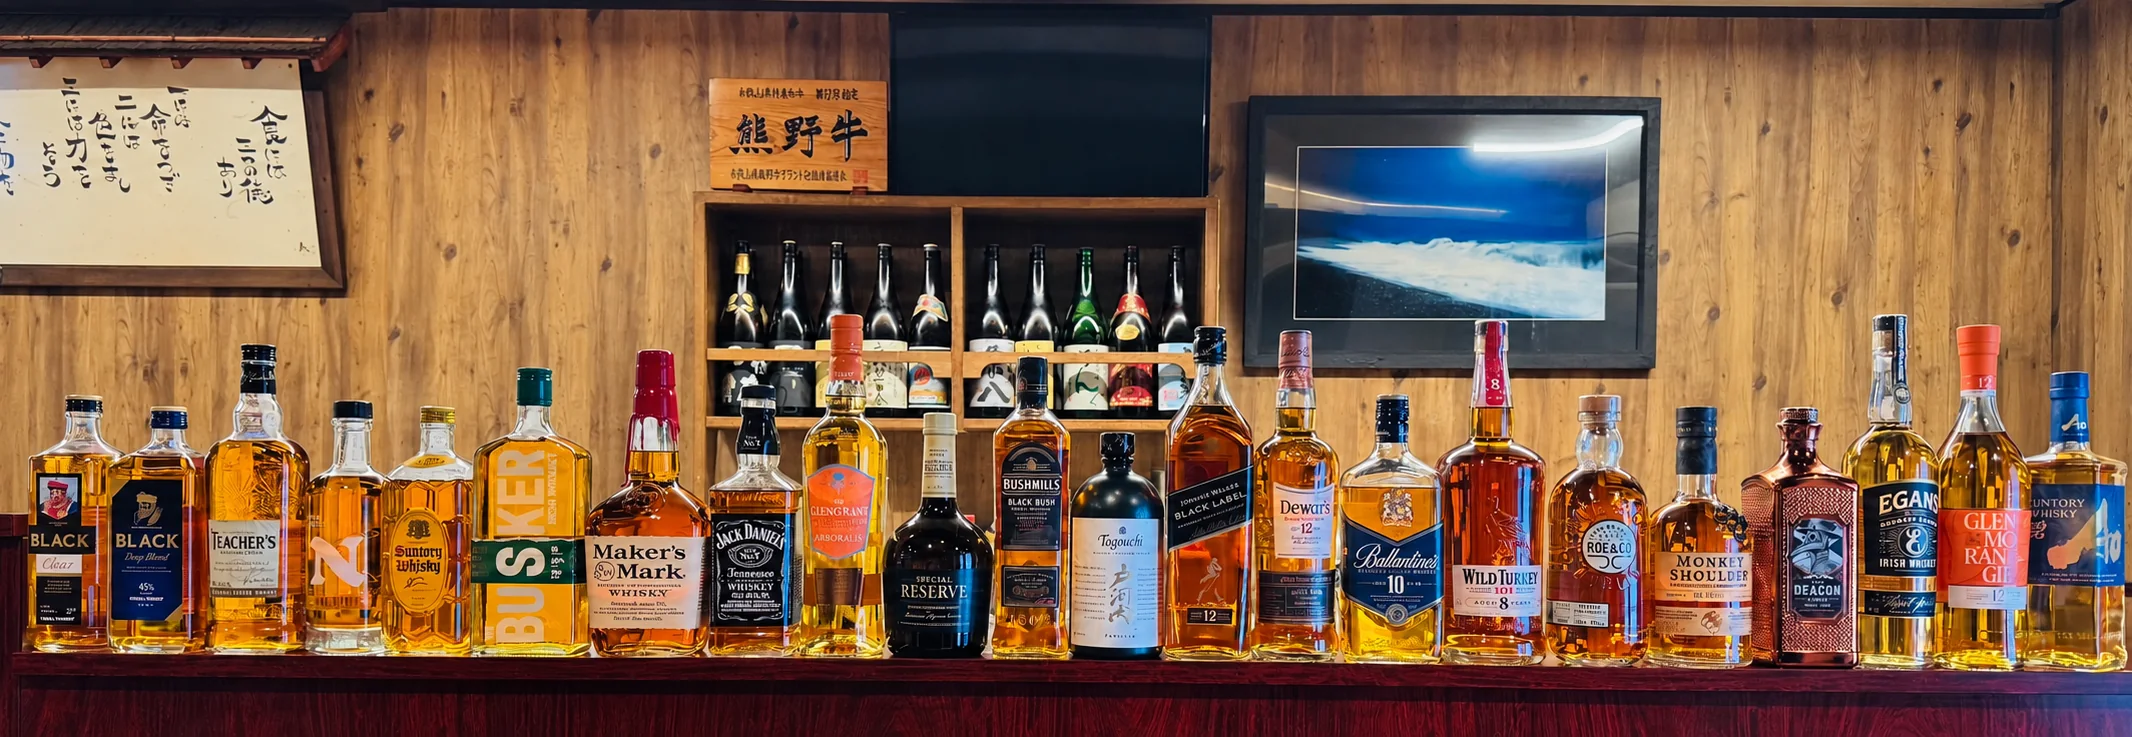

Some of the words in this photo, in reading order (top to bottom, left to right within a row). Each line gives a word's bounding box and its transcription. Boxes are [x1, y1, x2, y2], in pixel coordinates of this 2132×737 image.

[728, 109, 868, 163] 熊野牛
[1491, 378, 1500, 390] 8
[1003, 478, 1060, 490] BUSHMILLS
[1008, 498, 1033, 506] BLACK
[1035, 498, 1056, 506] BUSH
[1174, 502, 1210, 521] BLACK
[1212, 491, 1247, 508] LABEL
[1280, 500, 1331, 515] Dewar's
[2030, 498, 2085, 508] UNTORY
[1301, 522, 1313, 534] 12
[1963, 512, 2016, 530] GLEN
[30, 533, 89, 548] BLACK
[115, 533, 179, 548] BLACK
[210, 529, 277, 551] TEACHER'S
[716, 528, 744, 550] JACK
[814, 533, 863, 544] ARBORALIS
[1097, 534, 1143, 550] Togouchi
[1984, 530, 2017, 548] MO
[394, 545, 443, 560] Suntory
[495, 450, 546, 644] BUSKER
[593, 544, 686, 560] Maker's
[1587, 541, 1632, 554] ROE&CO
[42, 556, 74, 570] Clear
[1353, 543, 1439, 569] Ballantine's
[1676, 555, 1744, 568] MONKEY
[1879, 558, 1906, 568] IRISH
[1964, 547, 2007, 565] RAN
[396, 559, 441, 575] Whisky
[915, 575, 954, 583] SPECIAL
[1462, 568, 1498, 586] WILD
[1498, 569, 1539, 586] TURKEY
[1670, 569, 1749, 582] SHOULDER
[138, 582, 155, 592] 45%
[727, 583, 774, 591] WHISKEY
[901, 584, 969, 599] RESERVE
[1387, 574, 1405, 595] 10
[1495, 587, 1513, 595] 101
[1794, 585, 1841, 596] DEACON
[608, 589, 668, 598] WHISKY
[1992, 589, 2005, 602] 12
[1499, 596, 1509, 610] 8
[1203, 609, 1217, 622] 12
